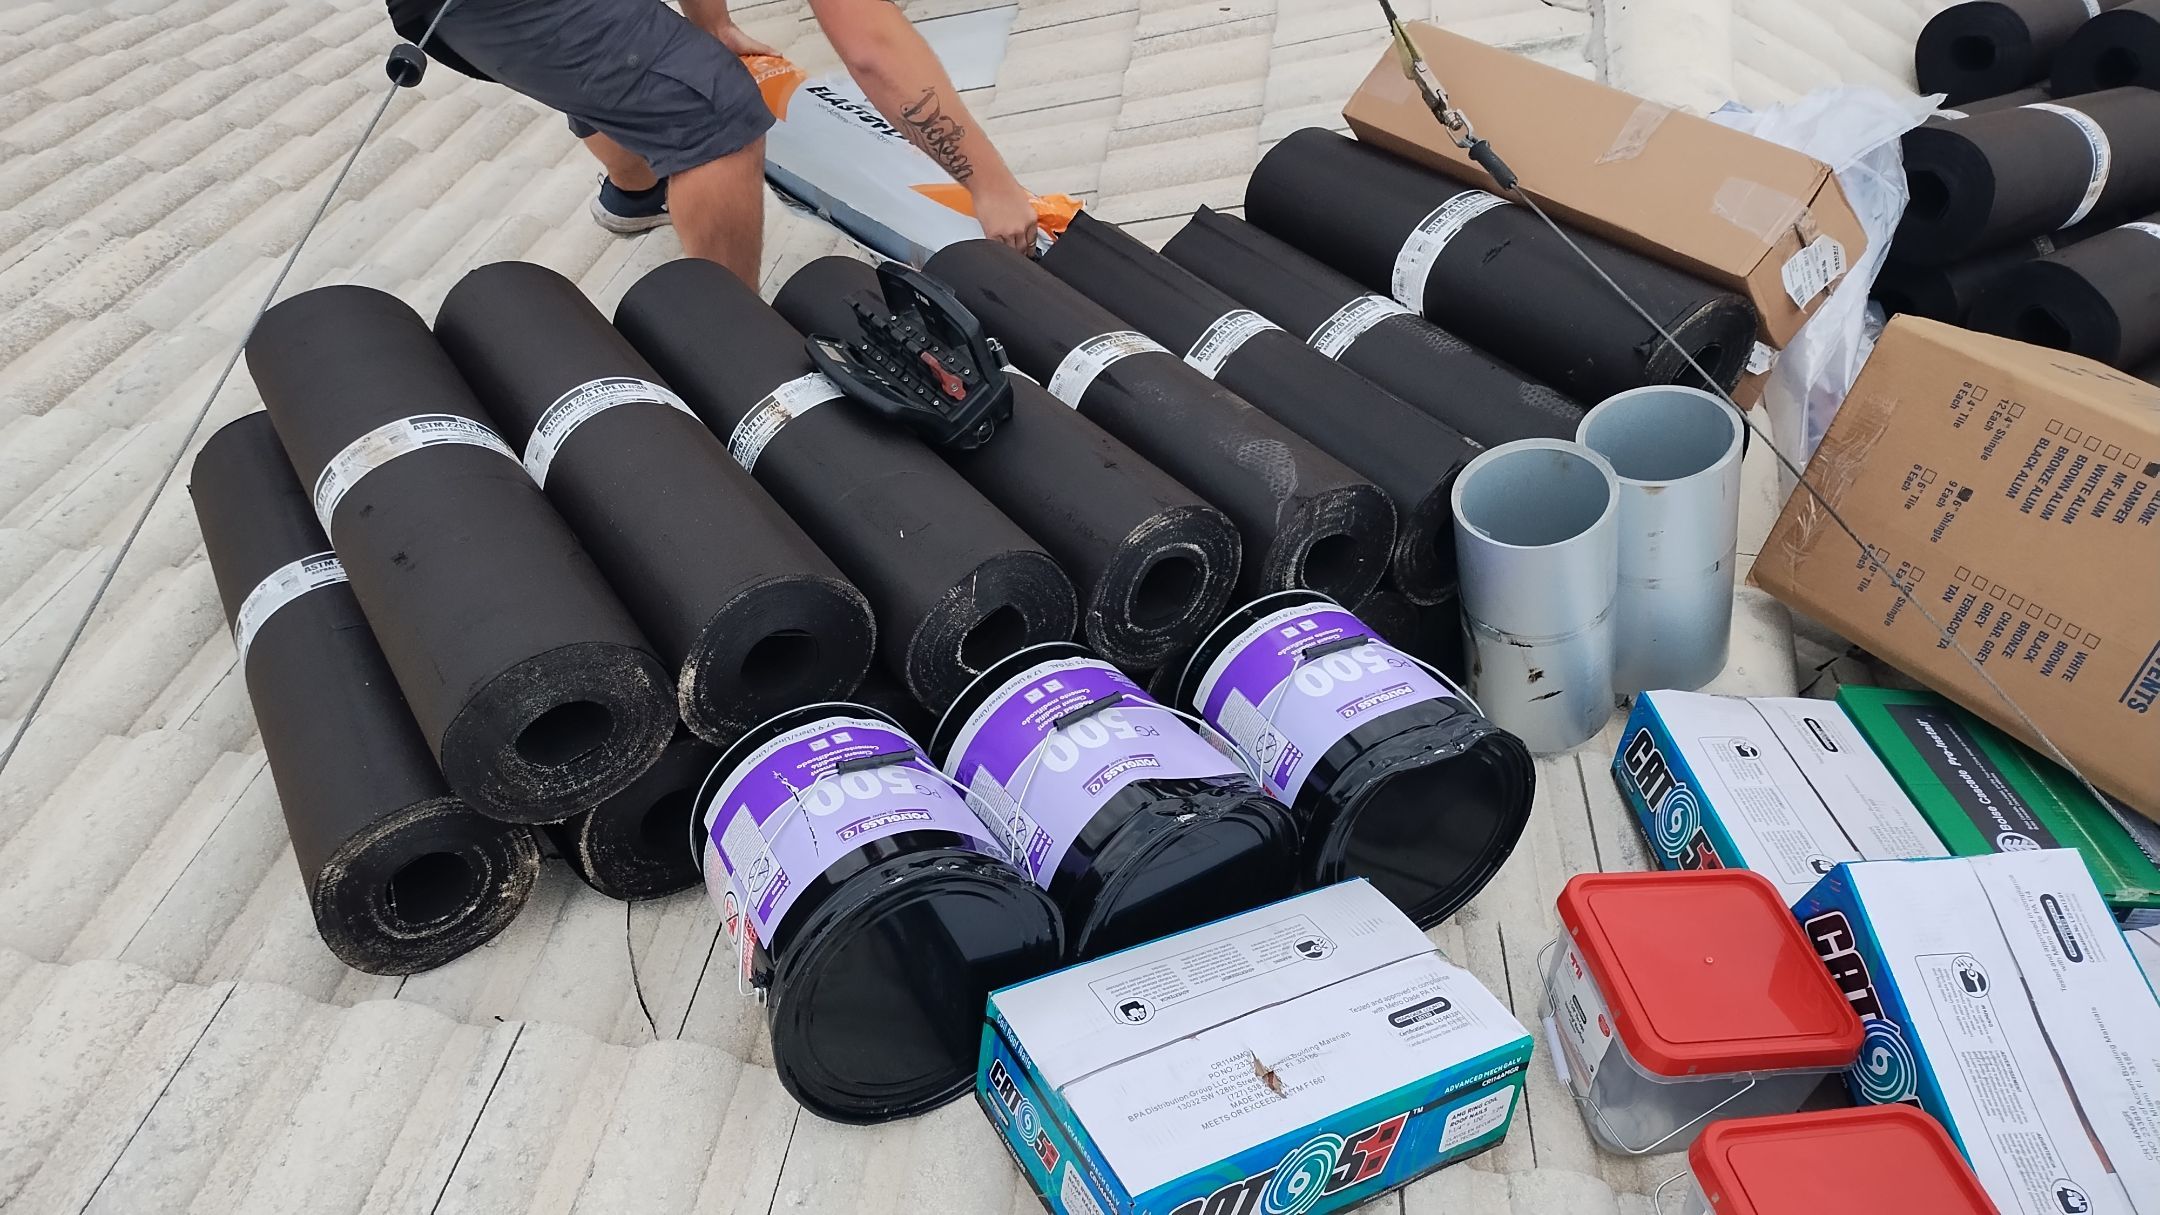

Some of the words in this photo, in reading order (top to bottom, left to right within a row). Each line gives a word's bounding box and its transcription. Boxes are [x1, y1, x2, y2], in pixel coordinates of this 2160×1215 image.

[806, 86, 906, 140] ELASTOFL
[1425, 218, 1444, 235] ASTM
[1086, 342, 1107, 356] ASTM
[1197, 342, 1215, 362] ASTM
[593, 385, 618, 395] TYPE
[1963, 381, 1972, 389] 8
[1950, 389, 1968, 409] Each
[1996, 399, 2009, 410] 12
[413, 422, 444, 431] ASTM
[742, 421, 758, 441] TYPE
[1953, 412, 1969, 428] Tile
[1984, 410, 2002, 431] Each
[1980, 428, 2006, 461] Shingle
[2022, 437, 2050, 471] BLACK
[2038, 445, 2069, 486] BRONZE
[2058, 454, 2088, 492] BROWN
[1901, 471, 1918, 491] Each
[2005, 469, 2029, 499] ALUM
[2080, 463, 2108, 496] WHITE
[2111, 471, 2128, 490] MF
[1904, 494, 1920, 510] Tile
[1936, 487, 1954, 508] Each
[2019, 484, 2043, 514] ALUM
[2040, 491, 2064, 520] ALUM
[2061, 494, 2086, 525] ALUM
[2090, 488, 2116, 518] ALUM
[2112, 480, 2147, 524] DAMPER
[1930, 511, 1955, 543] Shingle
[304, 560, 335, 573] ASTM
[1902, 561, 1911, 569] 6
[1857, 577, 1871, 592] Tile
[1942, 584, 1960, 603] TAN
[1884, 596, 1906, 627] Shingle
[1936, 593, 1977, 649] TERRACOTA
[1974, 602, 1994, 628] GREY
[1989, 611, 2012, 638] CHAR.
[2001, 620, 2031, 659] BRONZE
[2023, 630, 2050, 663] BLACK
[1974, 640, 1995, 666] GREY
[2040, 641, 2069, 677] BROWN
[1294, 645, 1392, 697] 500
[2061, 651, 2088, 683] WHITE
[1060, 688, 1091, 701] Cemento
[1061, 695, 1087, 709] Ciment
[1357, 686, 1413, 710] POLYGLASS
[1021, 695, 1060, 726] modificado
[1037, 712, 1064, 731] Cement
[1041, 709, 1140, 773] 500
[1135, 725, 1160, 738] PG
[796, 750, 840, 770] modificado
[1103, 757, 1160, 782] POLYGLASS
[1624, 727, 1679, 813] CAT
[805, 766, 917, 817] 500
[1958, 769, 1991, 804] Cascade
[862, 810, 931, 832] POLYGLASS
[1988, 806, 2012, 830] Boise
[2030, 920, 2049, 952] approved
[2037, 915, 2049, 934] Dade
[2047, 935, 2060, 956] Metro
[2046, 953, 2056, 967] and
[2057, 957, 2067, 972] with
[2052, 968, 2067, 992] Tested
[1349, 1002, 1371, 1014] Tested
[1371, 998, 1383, 1007] and
[1383, 988, 1411, 1003] approved
[1412, 985, 1419, 993] in
[1372, 1006, 1385, 1015] with
[1385, 1000, 1404, 1010] Metro
[1403, 993, 1421, 1004] Dade
[1420, 989, 1431, 997] PA
[2091, 1006, 2112, 1043] Materials
[997, 1014, 1007, 1032] Coil
[1006, 1028, 1018, 1048] Roof
[1018, 1044, 1033, 1069] Nails
[2110, 1044, 2129, 1077] Building
[989, 1058, 1025, 1116] CAT
[1127, 1111, 1145, 1123] BPA
[1145, 1092, 1190, 1116] Distribution
[1189, 1082, 1213, 1101] Group
[1319, 1031, 1352, 1047] Materials
[1208, 1071, 1220, 1079] PO
[1444, 1074, 1484, 1094] ADVANCED
[1483, 1066, 1503, 1078] MECH
[1502, 1056, 1522, 1069] GALV
[1177, 1096, 1201, 1112] 13032
[1201, 1092, 1214, 1102] SW
[1215, 1083, 1237, 1096] 128th
[1236, 1075, 1259, 1088] Stree
[1227, 1088, 1247, 1101] (727)
[1230, 1095, 1253, 1109] MADE
[1254, 1091, 1264, 1100] IN
[1201, 1114, 1230, 1131] MEETS
[1230, 1109, 1244, 1118] OR
[1243, 1094, 1281, 1113] EXCEEDS
[1449, 1116, 1468, 1127] ROOF
[1468, 1107, 1488, 1120] NAILS
[1452, 1110, 1467, 1120] AMG
[1467, 1103, 1483, 1114] RING
[1063, 1121, 1091, 1162] ADVANCED
[1091, 1161, 1107, 1184] MECH
[1105, 1182, 1120, 1206] GALV
